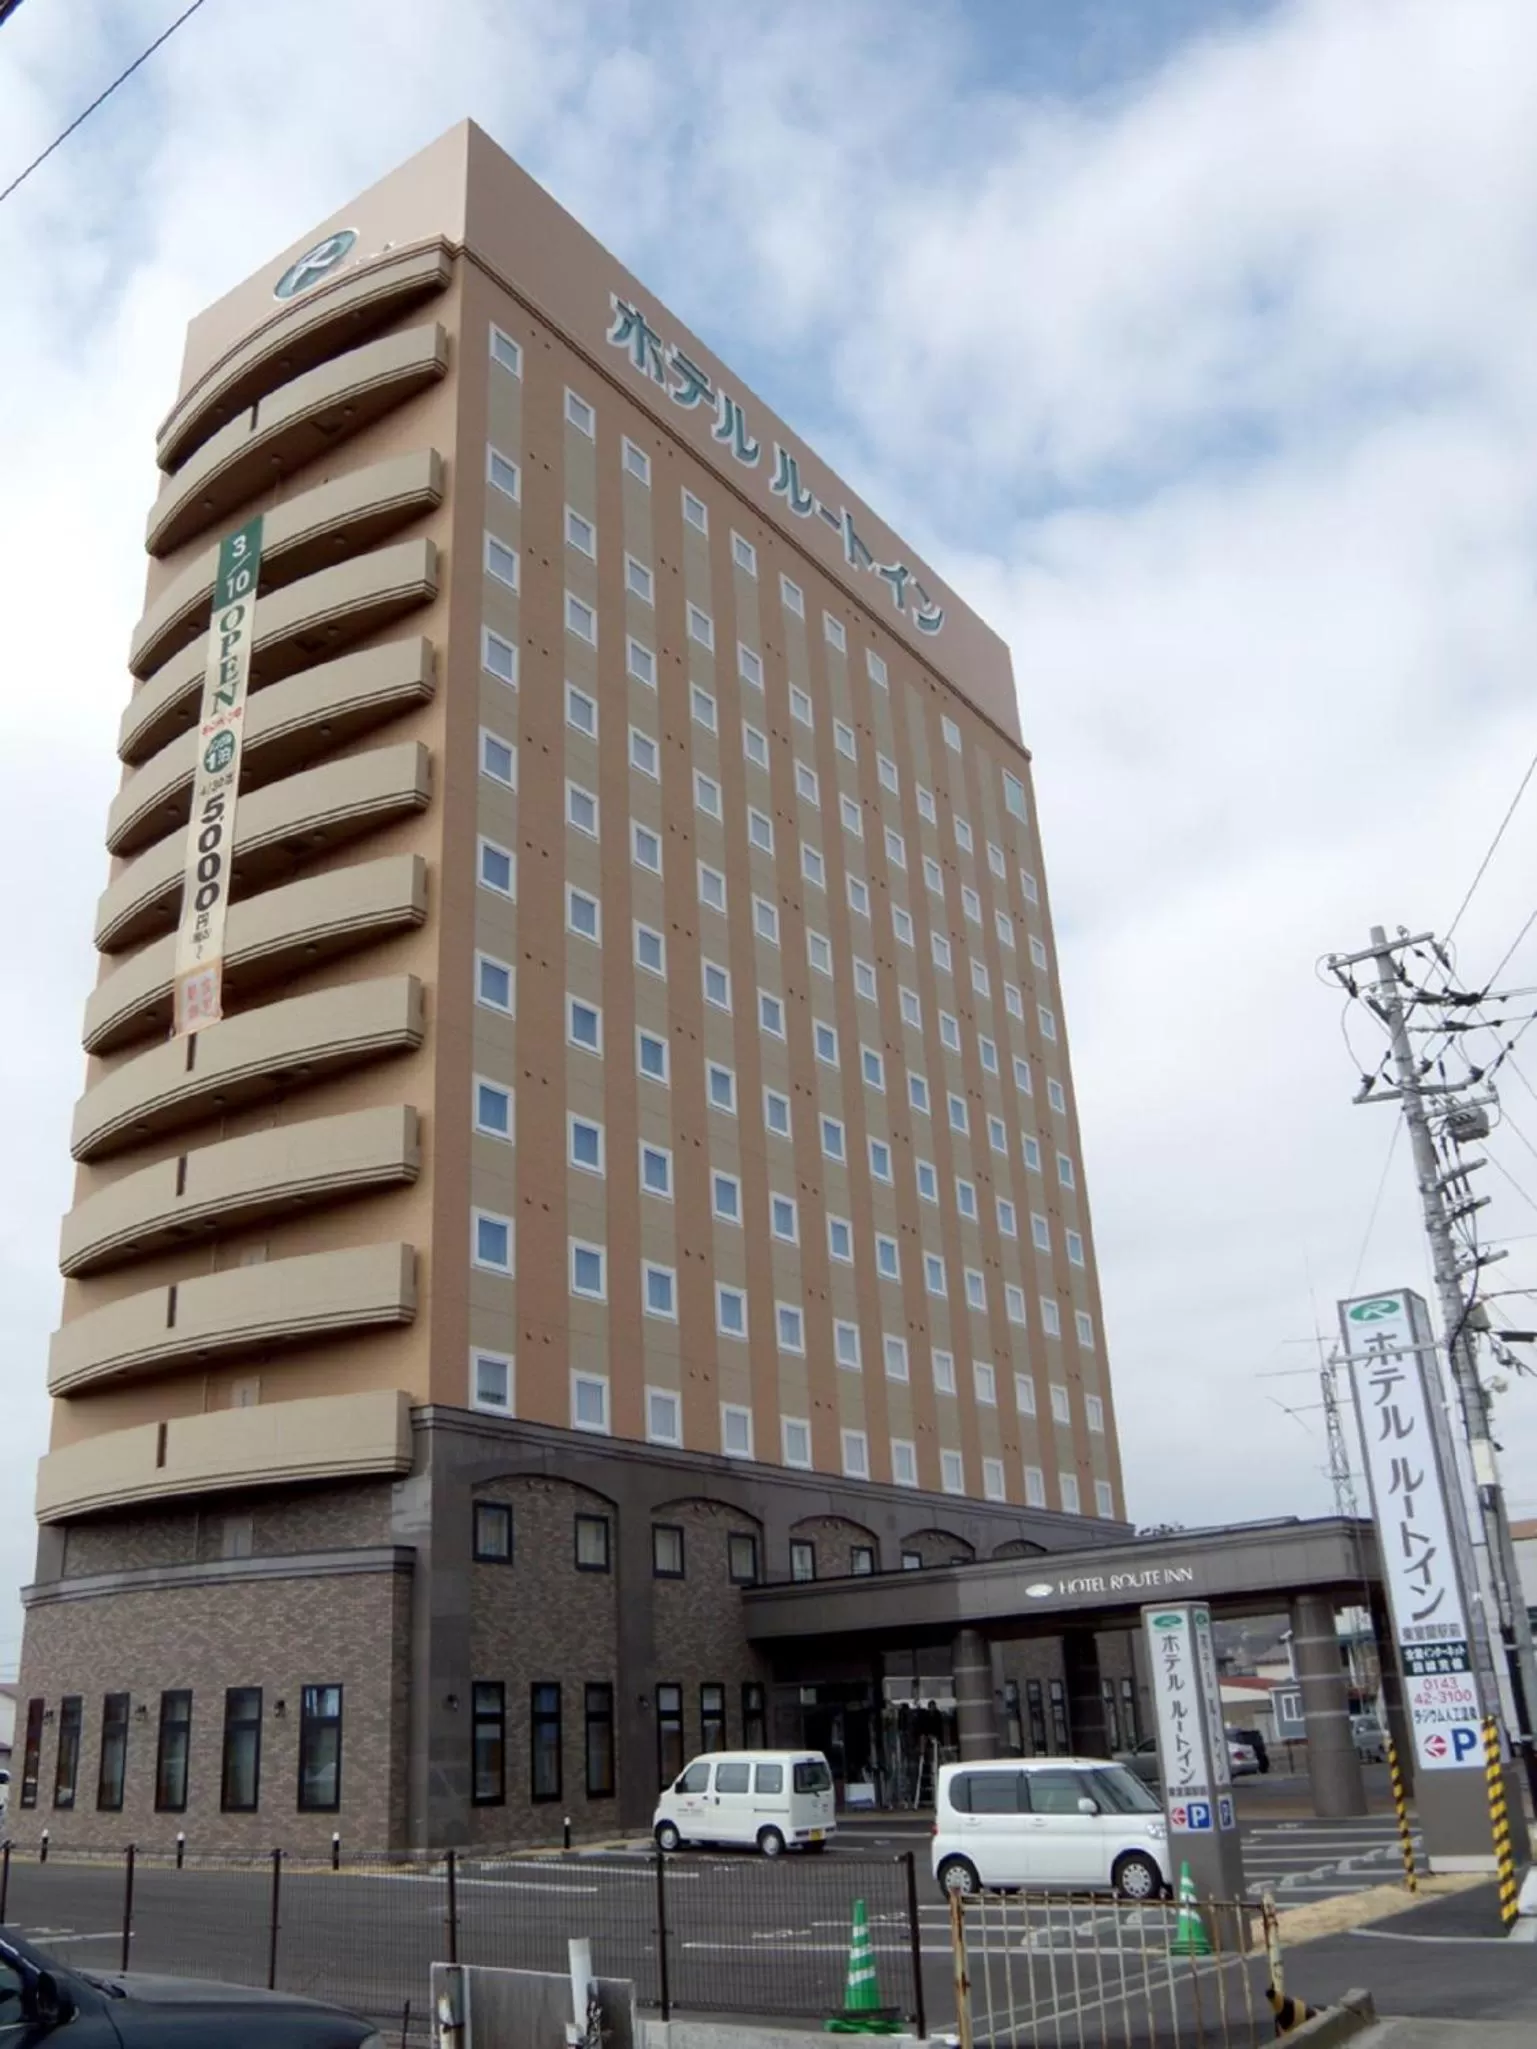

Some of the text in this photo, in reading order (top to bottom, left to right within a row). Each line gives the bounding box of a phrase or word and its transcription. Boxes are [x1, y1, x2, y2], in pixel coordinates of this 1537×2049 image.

[606, 292, 944, 636] ホテル ルートイン
[211, 604, 245, 716] OPEN
[1364, 1331, 1445, 1622] ホテル ルートイン
[1059, 1566, 1193, 1595] HOTEL ROUTE INN
[1162, 1634, 1186, 1692] ホテル
[1170, 1700, 1196, 1785] ルートイン
[1452, 1728, 1477, 1762] P
[1190, 1805, 1206, 1828] P
